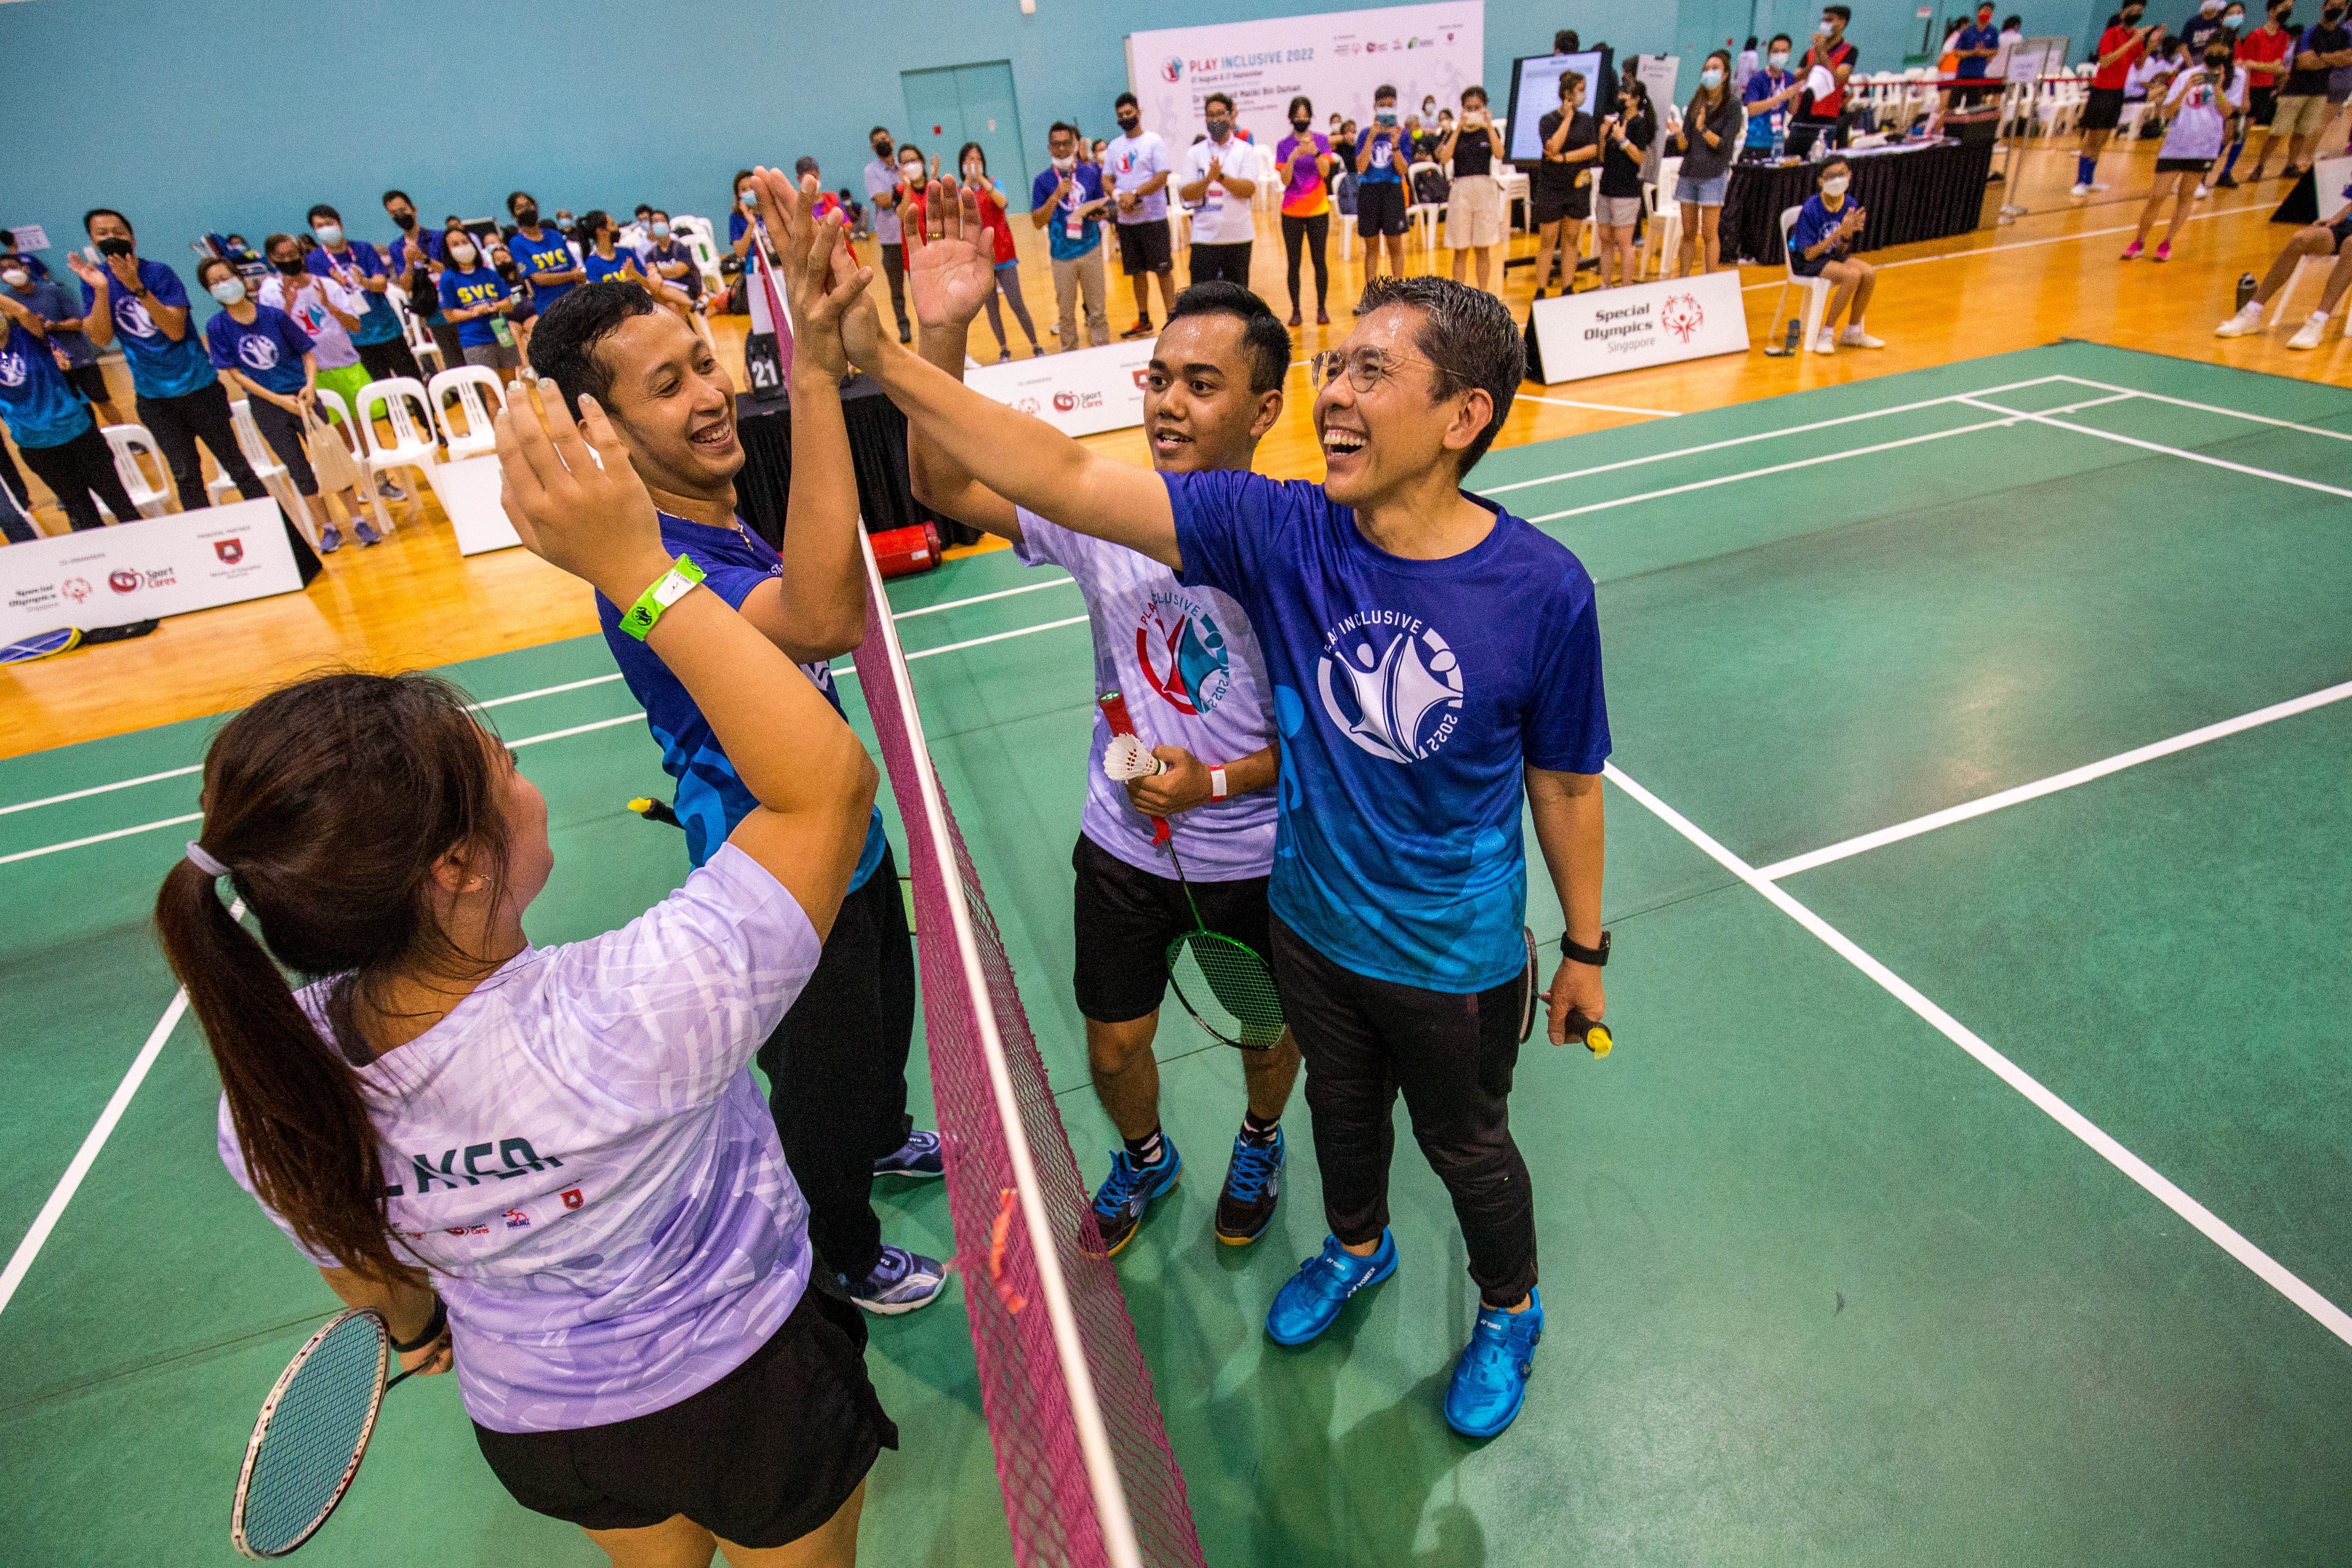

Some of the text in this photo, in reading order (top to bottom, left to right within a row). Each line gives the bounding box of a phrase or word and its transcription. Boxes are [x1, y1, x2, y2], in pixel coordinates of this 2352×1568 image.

[1190, 48, 1313, 71] PLAY INCLUSIVE 2022
[532, 248, 566, 269] SVC
[457, 283, 499, 303] SVC
[1596, 303, 1650, 322] Special
[1585, 322, 1653, 341] Olympics
[1607, 336, 1656, 353] Singapore
[752, 359, 778, 387] 21
[1081, 391, 1102, 402] Sport
[1082, 399, 1102, 408] Cares
[146, 567, 174, 580] Sport
[148, 577, 176, 588] Cares
[1338, 610, 1422, 634] INCLUSIVE
[1208, 679, 1229, 708] 2022
[1426, 714, 1458, 751] 2022
[1357, 1267, 1375, 1287] YONEX
